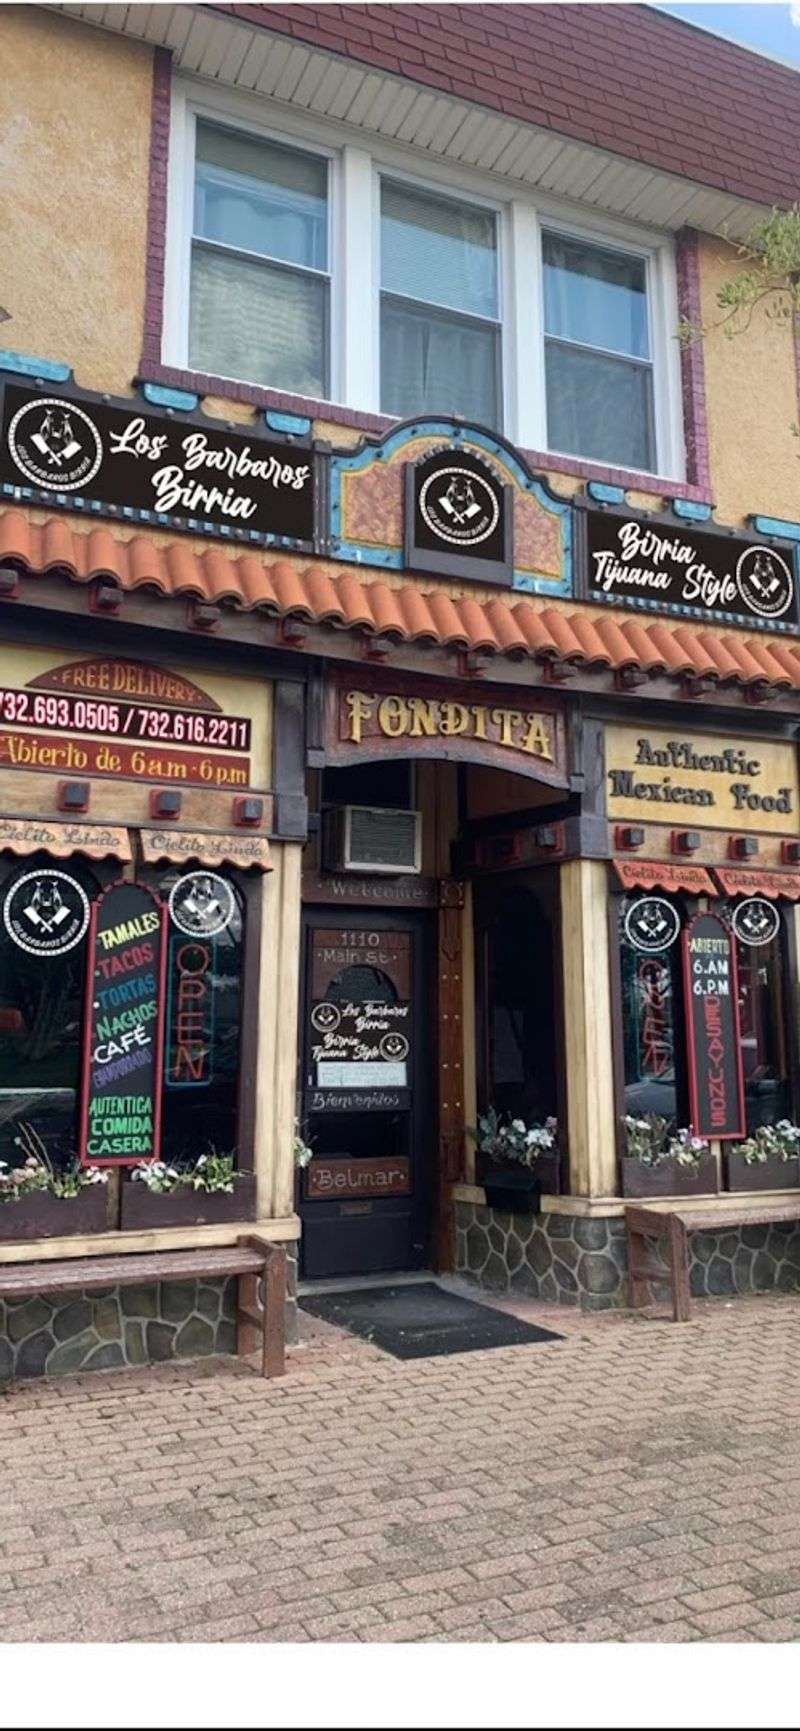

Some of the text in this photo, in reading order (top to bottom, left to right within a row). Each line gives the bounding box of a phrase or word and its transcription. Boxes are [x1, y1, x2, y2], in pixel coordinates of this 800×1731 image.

[109, 417, 311, 490] Los Barbaros
[151, 464, 259, 520] Birria
[617, 521, 697, 566] Birria
[592, 551, 673, 592] Tijuana
[681, 563, 739, 608] Style
[62, 663, 196, 702] FREE DELIVERY
[138, 709, 248, 748] 732.616.2211
[346, 689, 554, 764] FONDITA
[95, 747, 122, 772] de
[634, 738, 761, 777] Authentic
[608, 769, 793, 814] Mexican Food
[329, 879, 423, 898] Welcome
[97, 911, 161, 950] TAMALES
[340, 932, 380, 947] 1110
[97, 942, 155, 979] TACOS
[323, 949, 361, 963] Main
[97, 973, 156, 1010] TORTAS
[175, 942, 210, 1080] OPEN
[96, 1000, 158, 1041] NACHOS
[94, 1023, 152, 1064] CAFÉ
[89, 1095, 153, 1117] AUTENTICA
[311, 1091, 400, 1110] Bienvenidos
[87, 1136, 153, 1156] CASERA
[91, 1116, 153, 1137] COMIDA
[316, 1168, 401, 1190] Belmar
